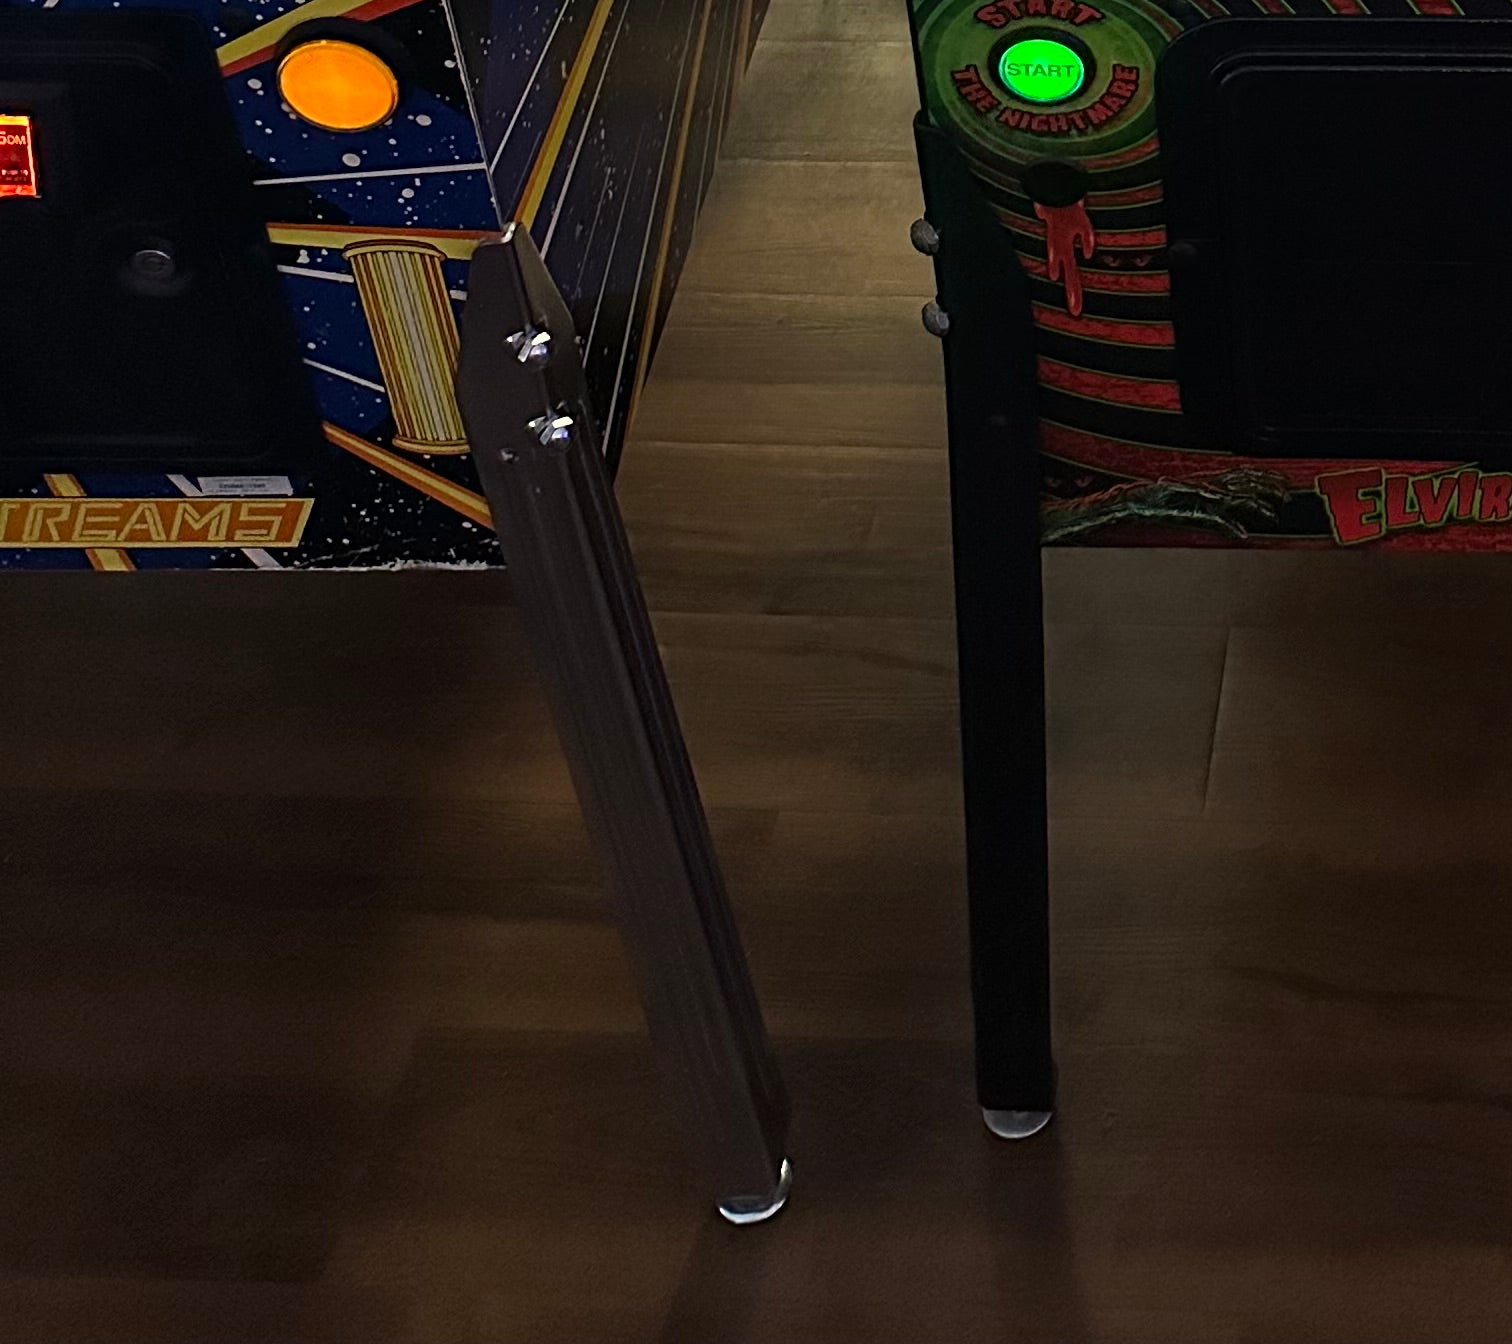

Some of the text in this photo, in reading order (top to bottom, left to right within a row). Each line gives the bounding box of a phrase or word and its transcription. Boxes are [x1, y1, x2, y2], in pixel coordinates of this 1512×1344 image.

[1006, 63, 1075, 78] START
[951, 63, 1141, 133] THE NIGHTMARE
